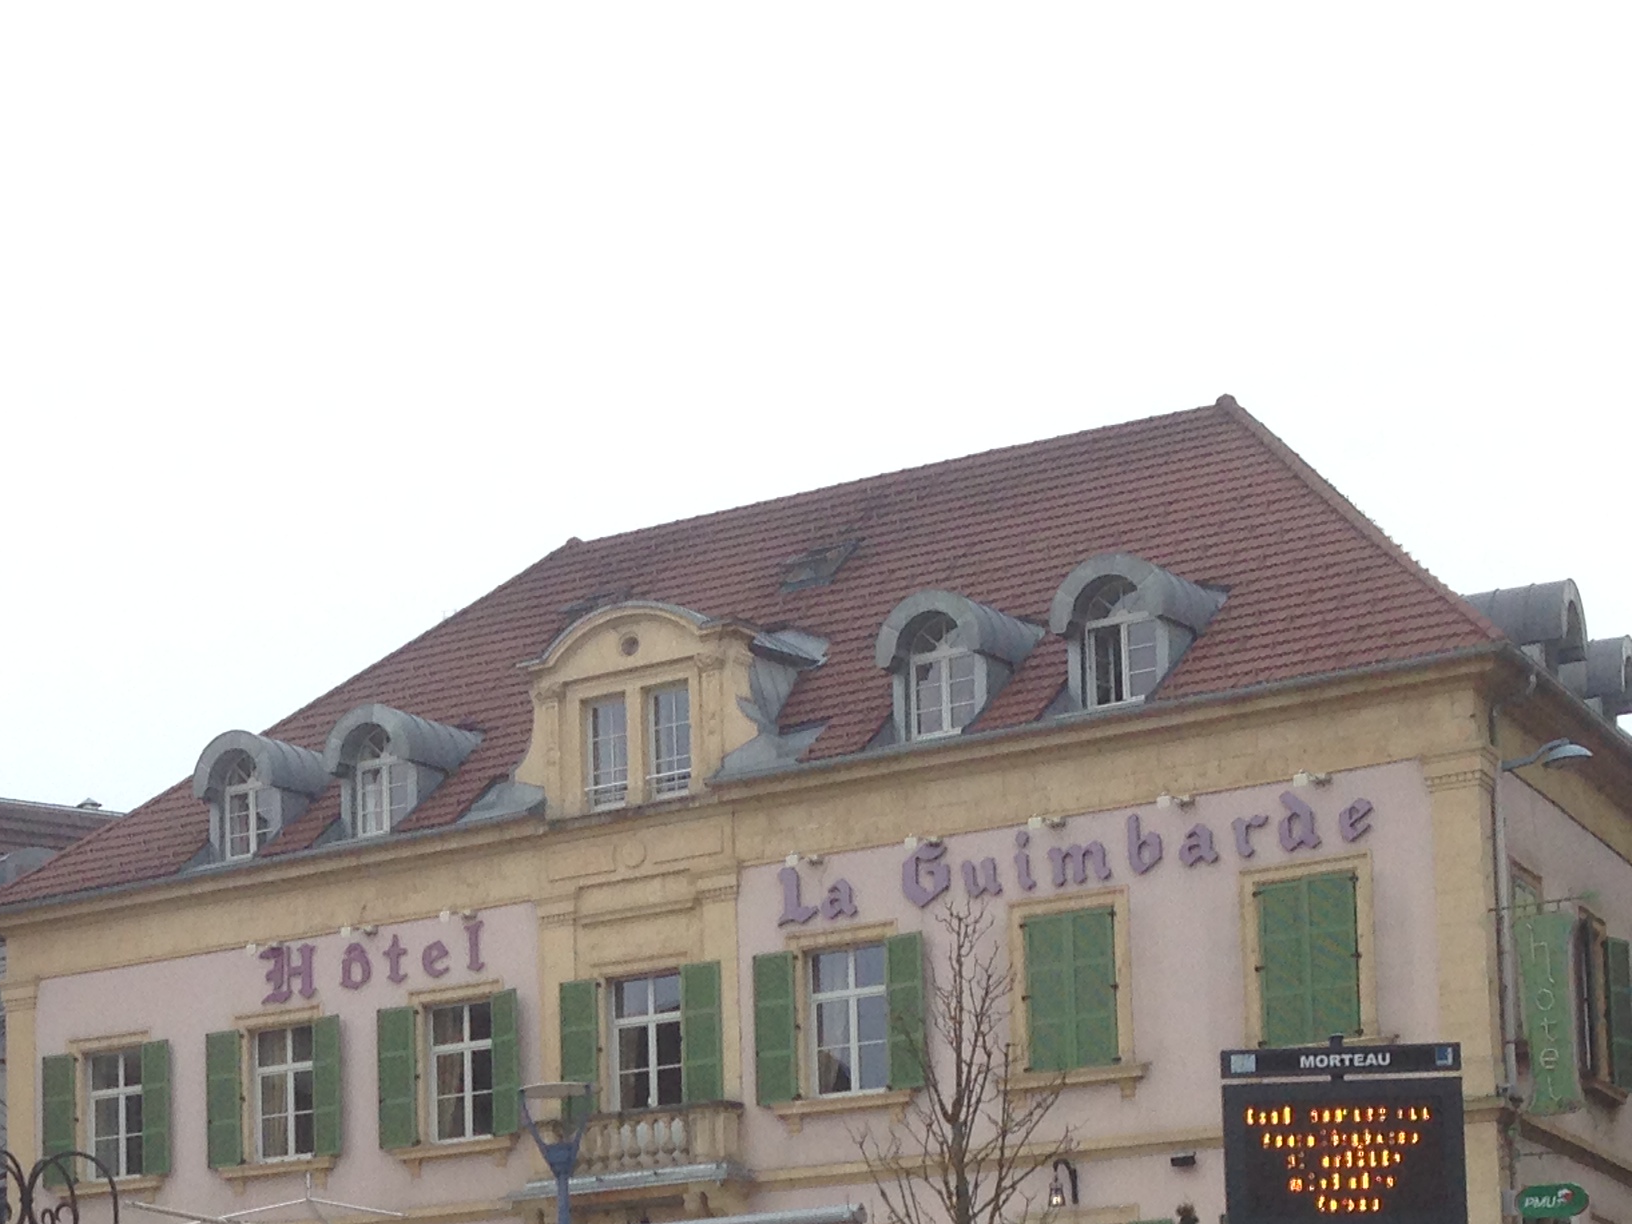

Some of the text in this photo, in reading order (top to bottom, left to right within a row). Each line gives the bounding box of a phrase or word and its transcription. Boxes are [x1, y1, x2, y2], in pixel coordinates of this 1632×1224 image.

[779, 790, 1374, 927] La Guimbarde
[1526, 922, 1561, 1101] hotel
[1299, 1052, 1391, 1069] MORTEAU
[1524, 1195, 1557, 1208] PMU
